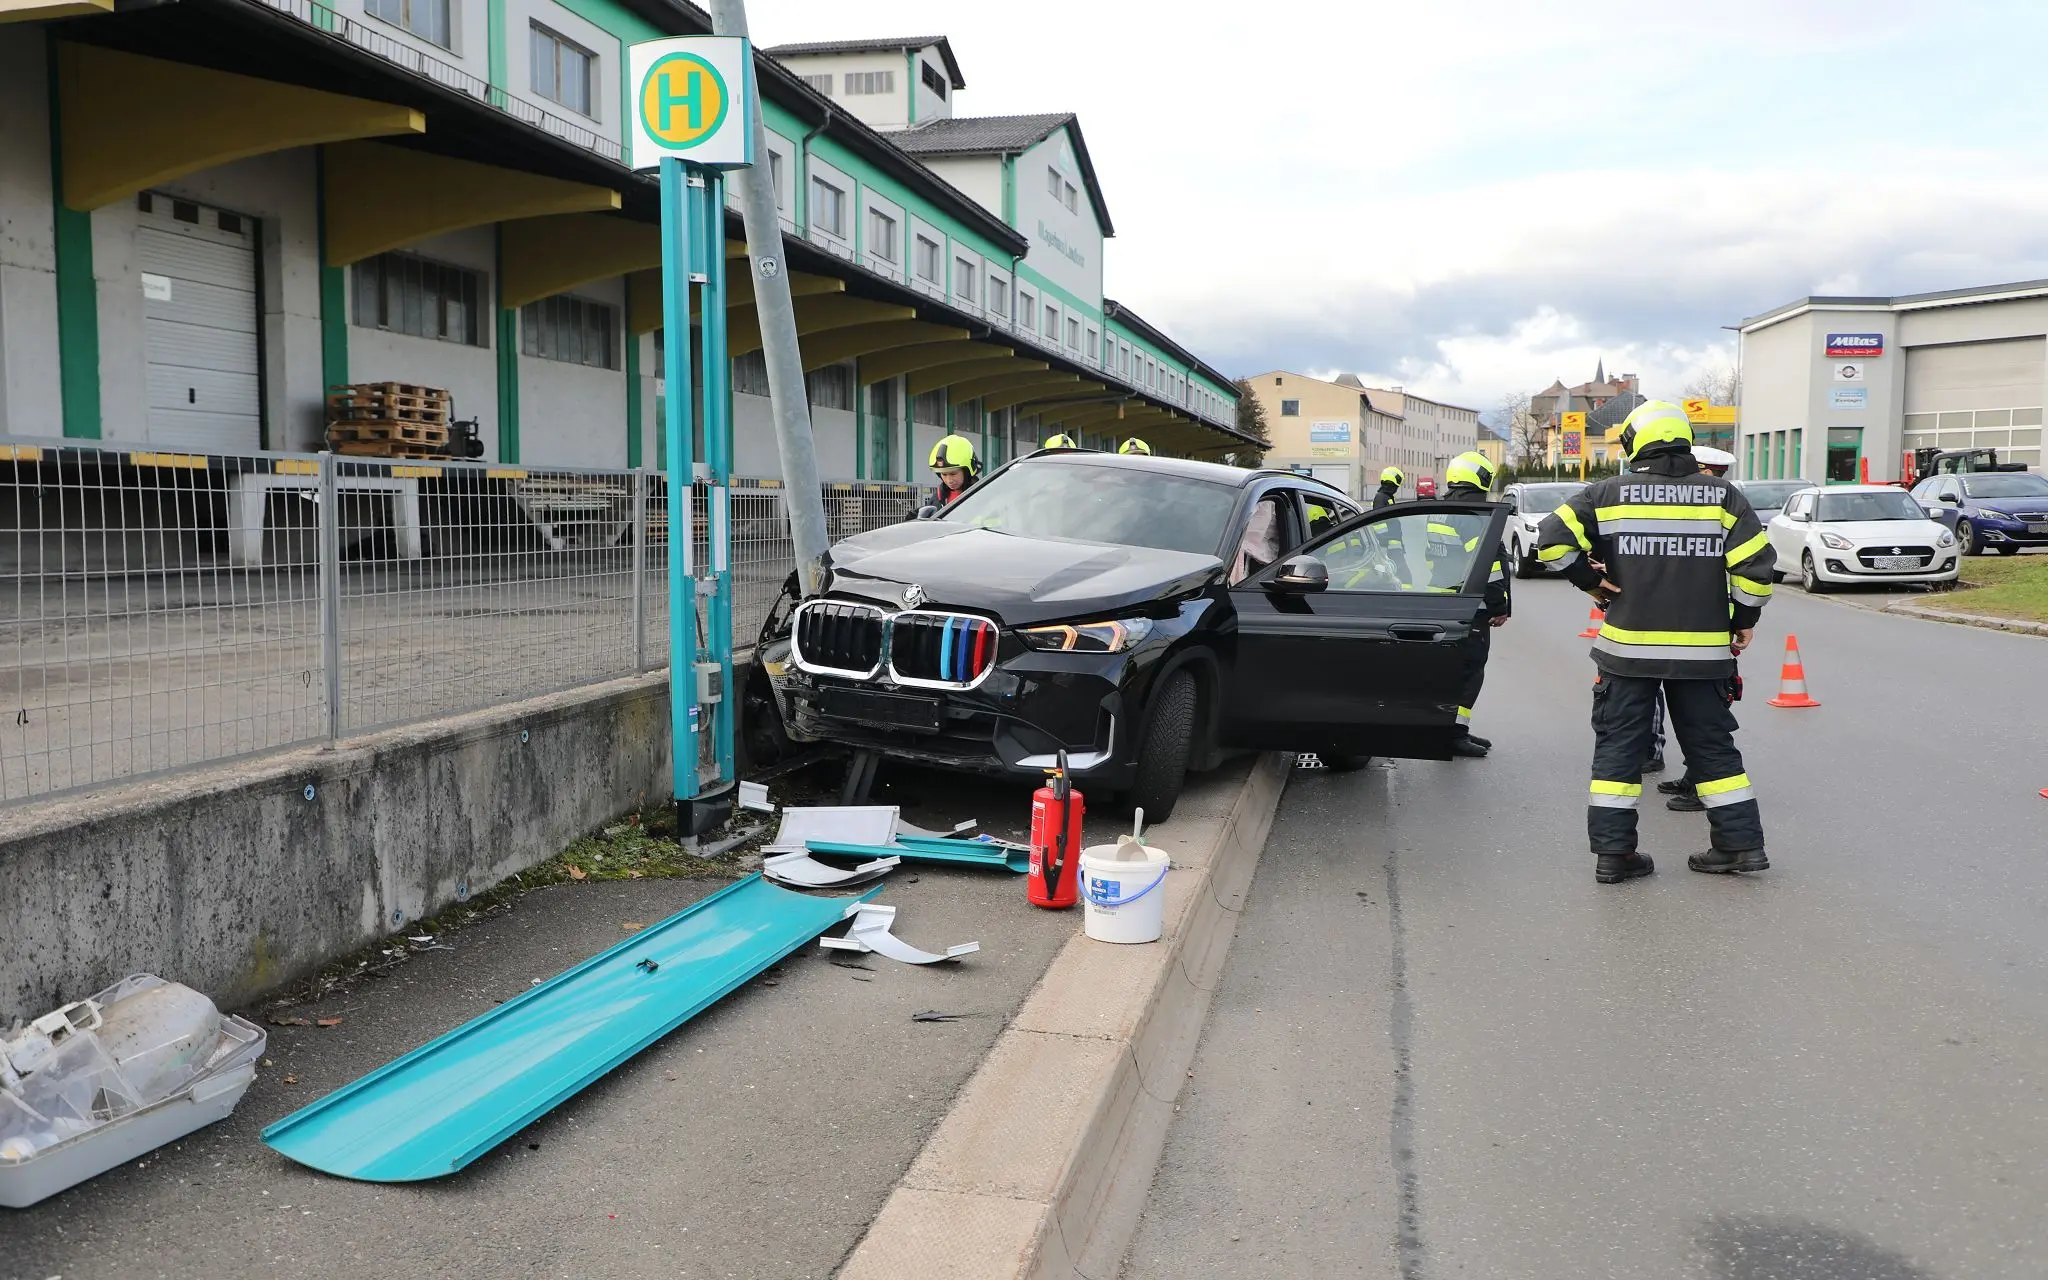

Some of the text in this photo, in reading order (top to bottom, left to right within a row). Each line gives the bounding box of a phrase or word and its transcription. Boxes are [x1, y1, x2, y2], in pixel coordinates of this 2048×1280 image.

[658, 71, 701, 130] H
[1830, 336, 1879, 346] Mitas
[1916, 436, 1922, 446] 1
[1620, 484, 1727, 504] FEUERWEHR
[1618, 535, 1724, 557] KNITTELFELD
